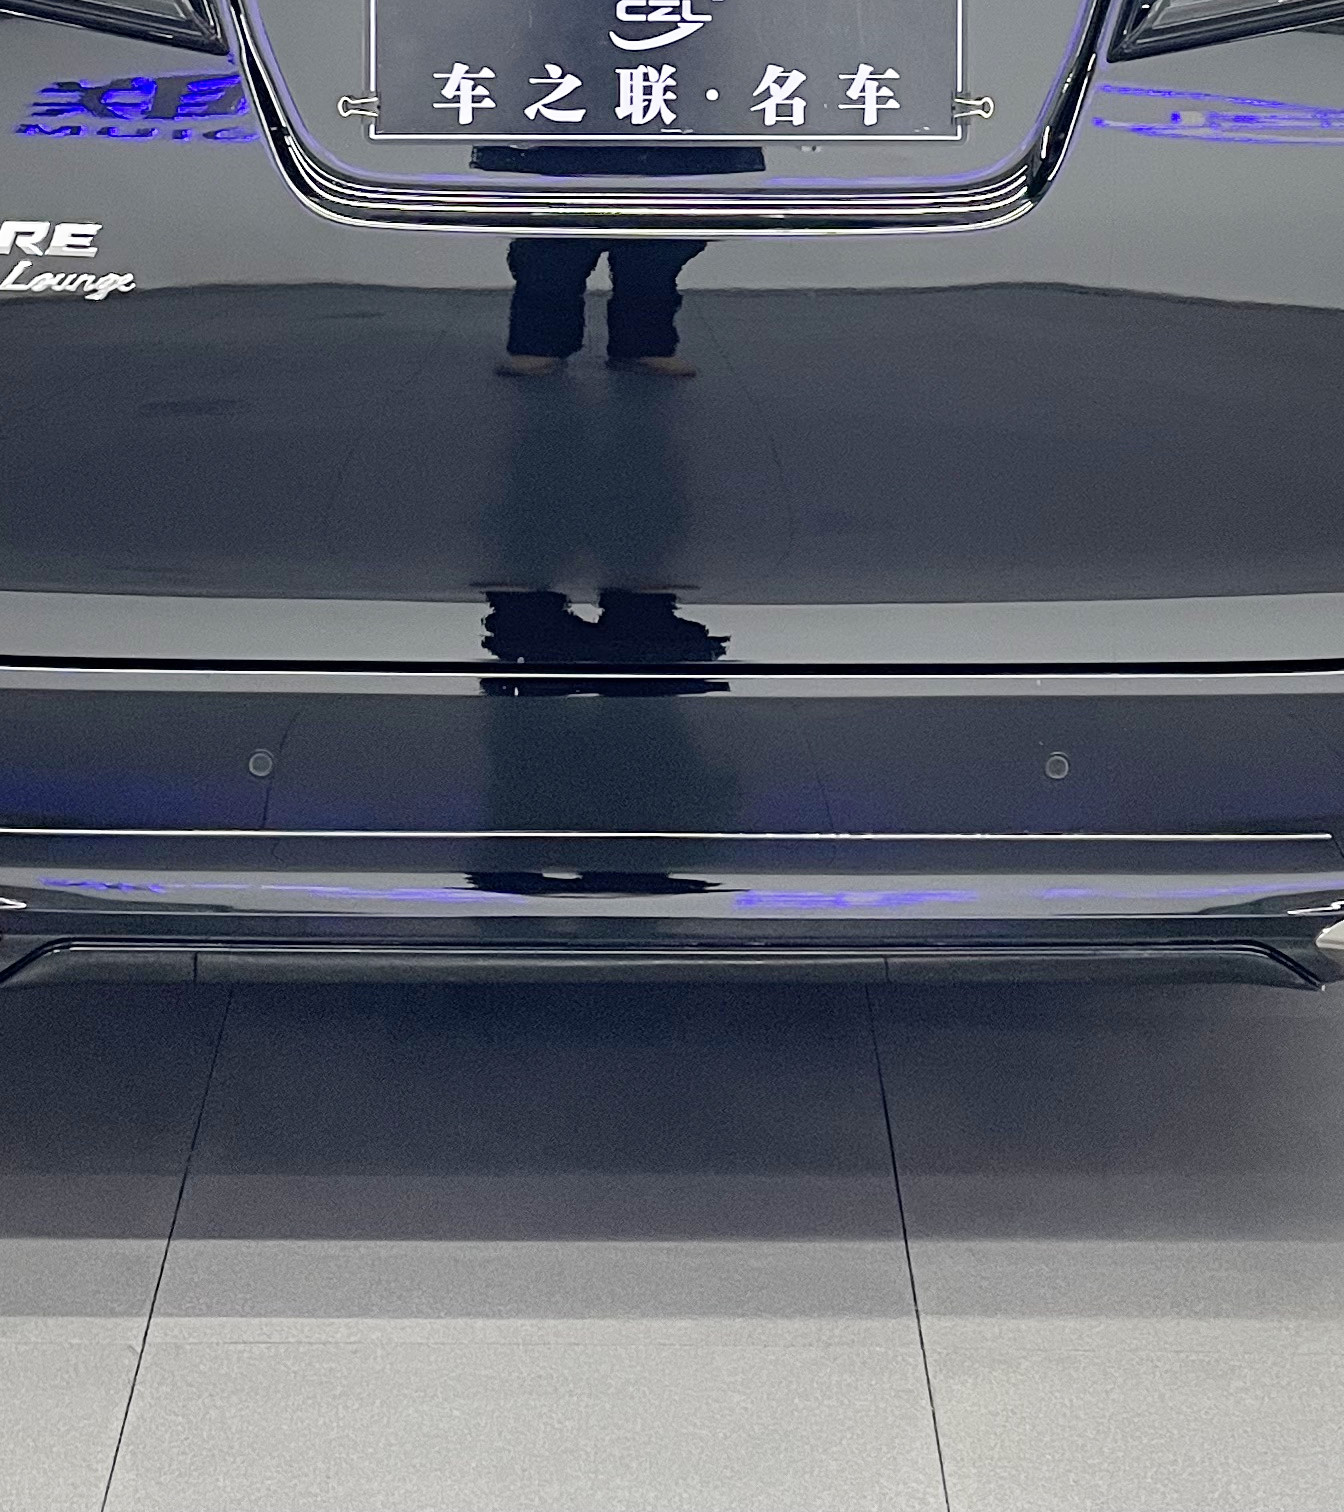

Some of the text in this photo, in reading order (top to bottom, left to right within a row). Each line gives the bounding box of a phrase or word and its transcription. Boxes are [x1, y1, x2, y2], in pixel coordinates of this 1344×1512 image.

[432, 62, 901, 126] 车之联·名车
